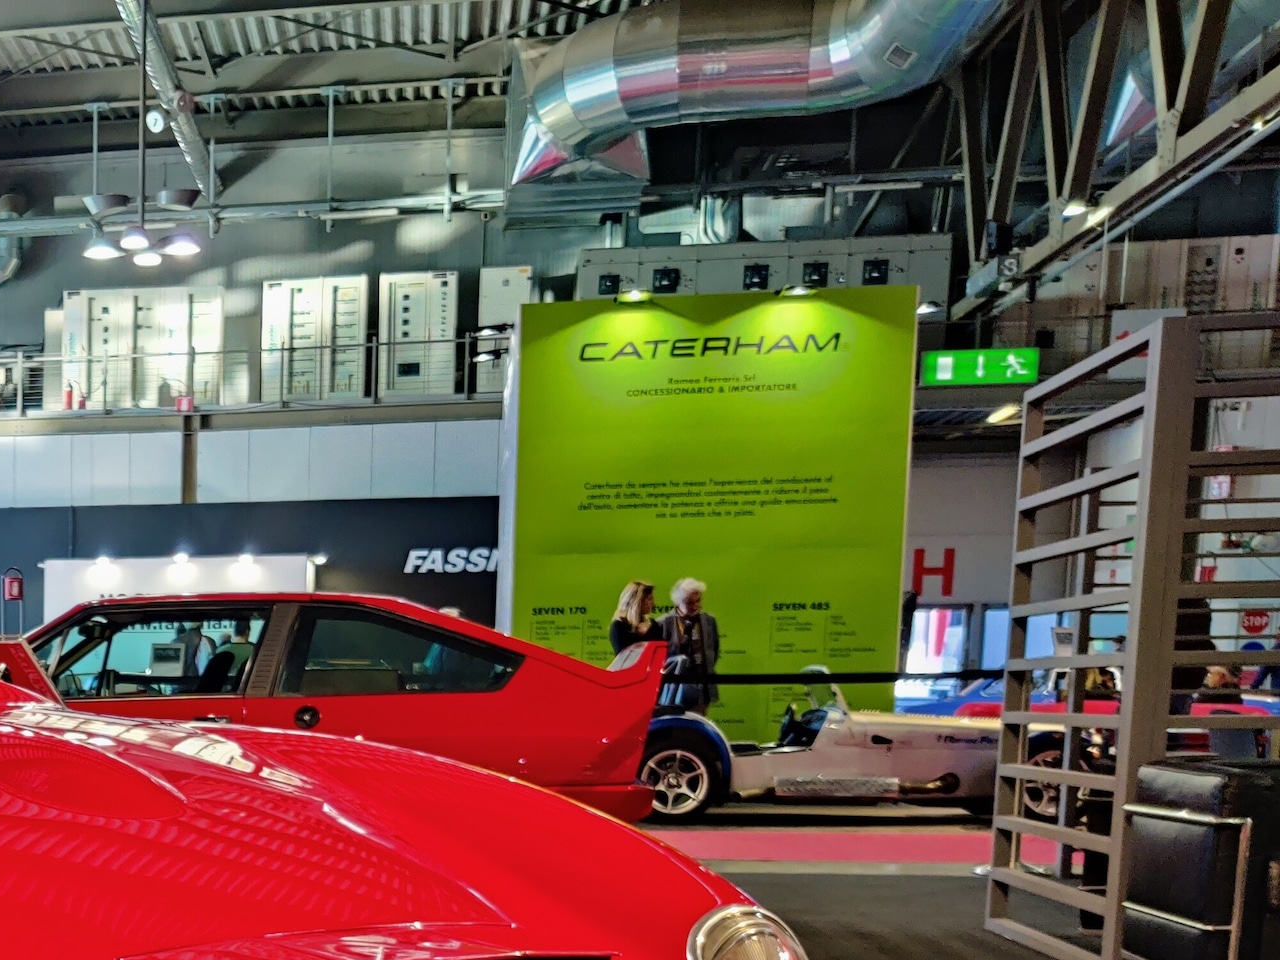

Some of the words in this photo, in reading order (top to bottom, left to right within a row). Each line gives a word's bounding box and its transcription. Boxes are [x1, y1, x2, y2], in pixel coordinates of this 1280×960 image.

[578, 332, 842, 362] CATERHAM
[626, 385, 714, 398] CONCESSIONARIO
[717, 385, 725, 394] &
[728, 383, 797, 394] IMPORTATORE
[583, 481, 623, 490] Caterham
[912, 548, 956, 597] H
[532, 606, 565, 616] SEVEN
[569, 606, 587, 615] 170
[772, 602, 807, 612] SEVEN
[1242, 616, 1269, 627] STOP
